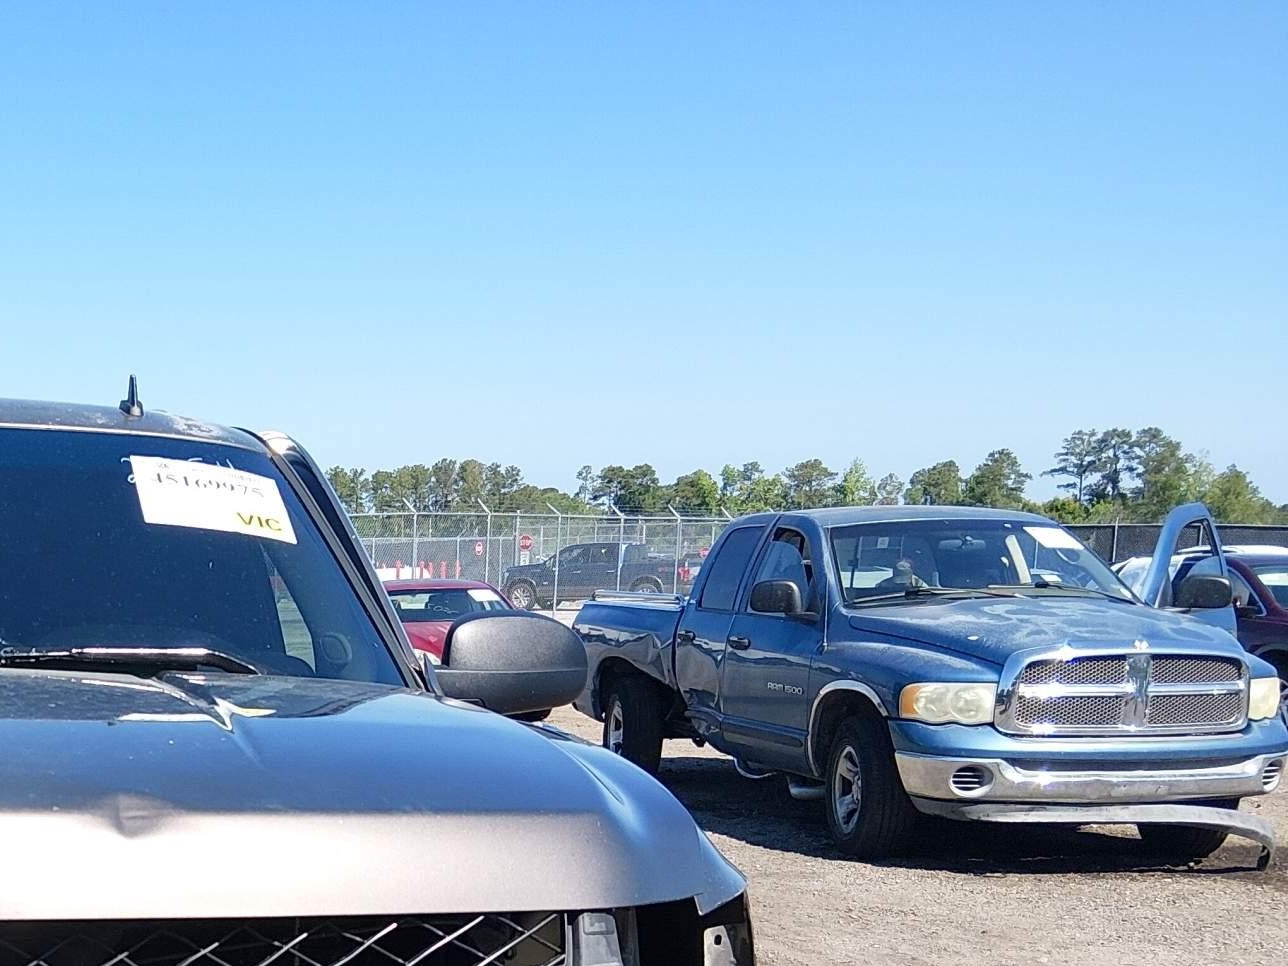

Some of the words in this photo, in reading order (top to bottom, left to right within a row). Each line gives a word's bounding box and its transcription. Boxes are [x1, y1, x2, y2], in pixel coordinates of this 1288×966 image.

[236, 511, 283, 532] VIC
[767, 682, 783, 691] RAM
[784, 685, 803, 695] 1500
